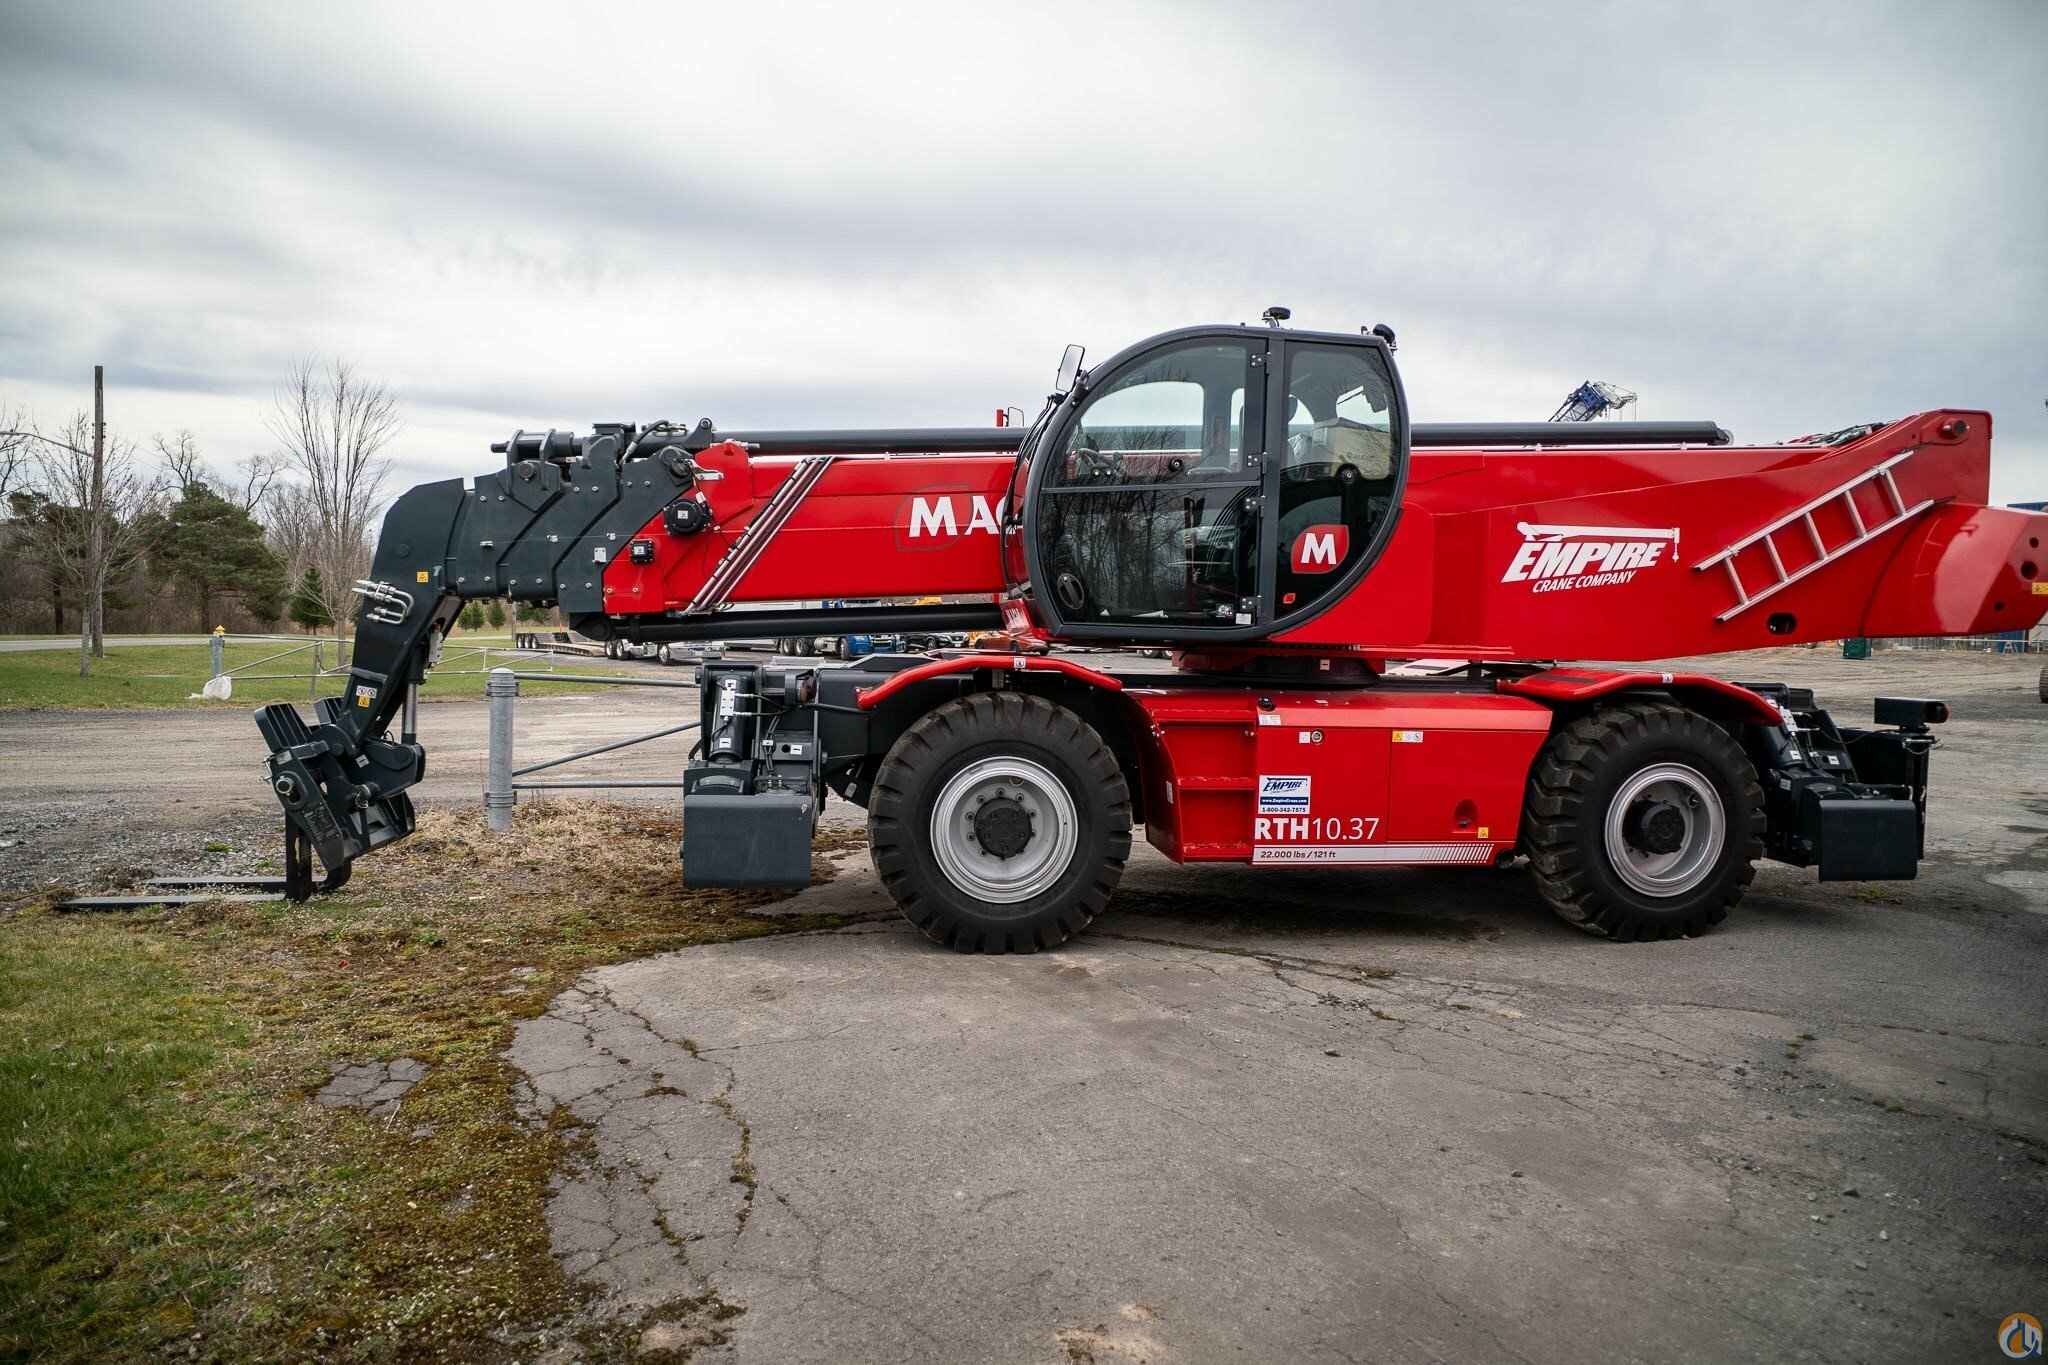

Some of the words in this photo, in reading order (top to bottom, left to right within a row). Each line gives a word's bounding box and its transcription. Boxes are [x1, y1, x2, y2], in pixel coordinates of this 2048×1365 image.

[909, 495, 1006, 537] MA
[1301, 532, 1337, 565] M
[1501, 542, 1667, 583] EMPIRE
[1533, 576, 1576, 593] CRANE
[1575, 570, 1637, 589] COMPANY
[1263, 781, 1302, 792] EMPIRE
[1260, 850, 1292, 859] 22.000
[1293, 850, 1306, 858] lbs
[1314, 850, 1327, 858] 121
[1328, 850, 1337, 858] ft
